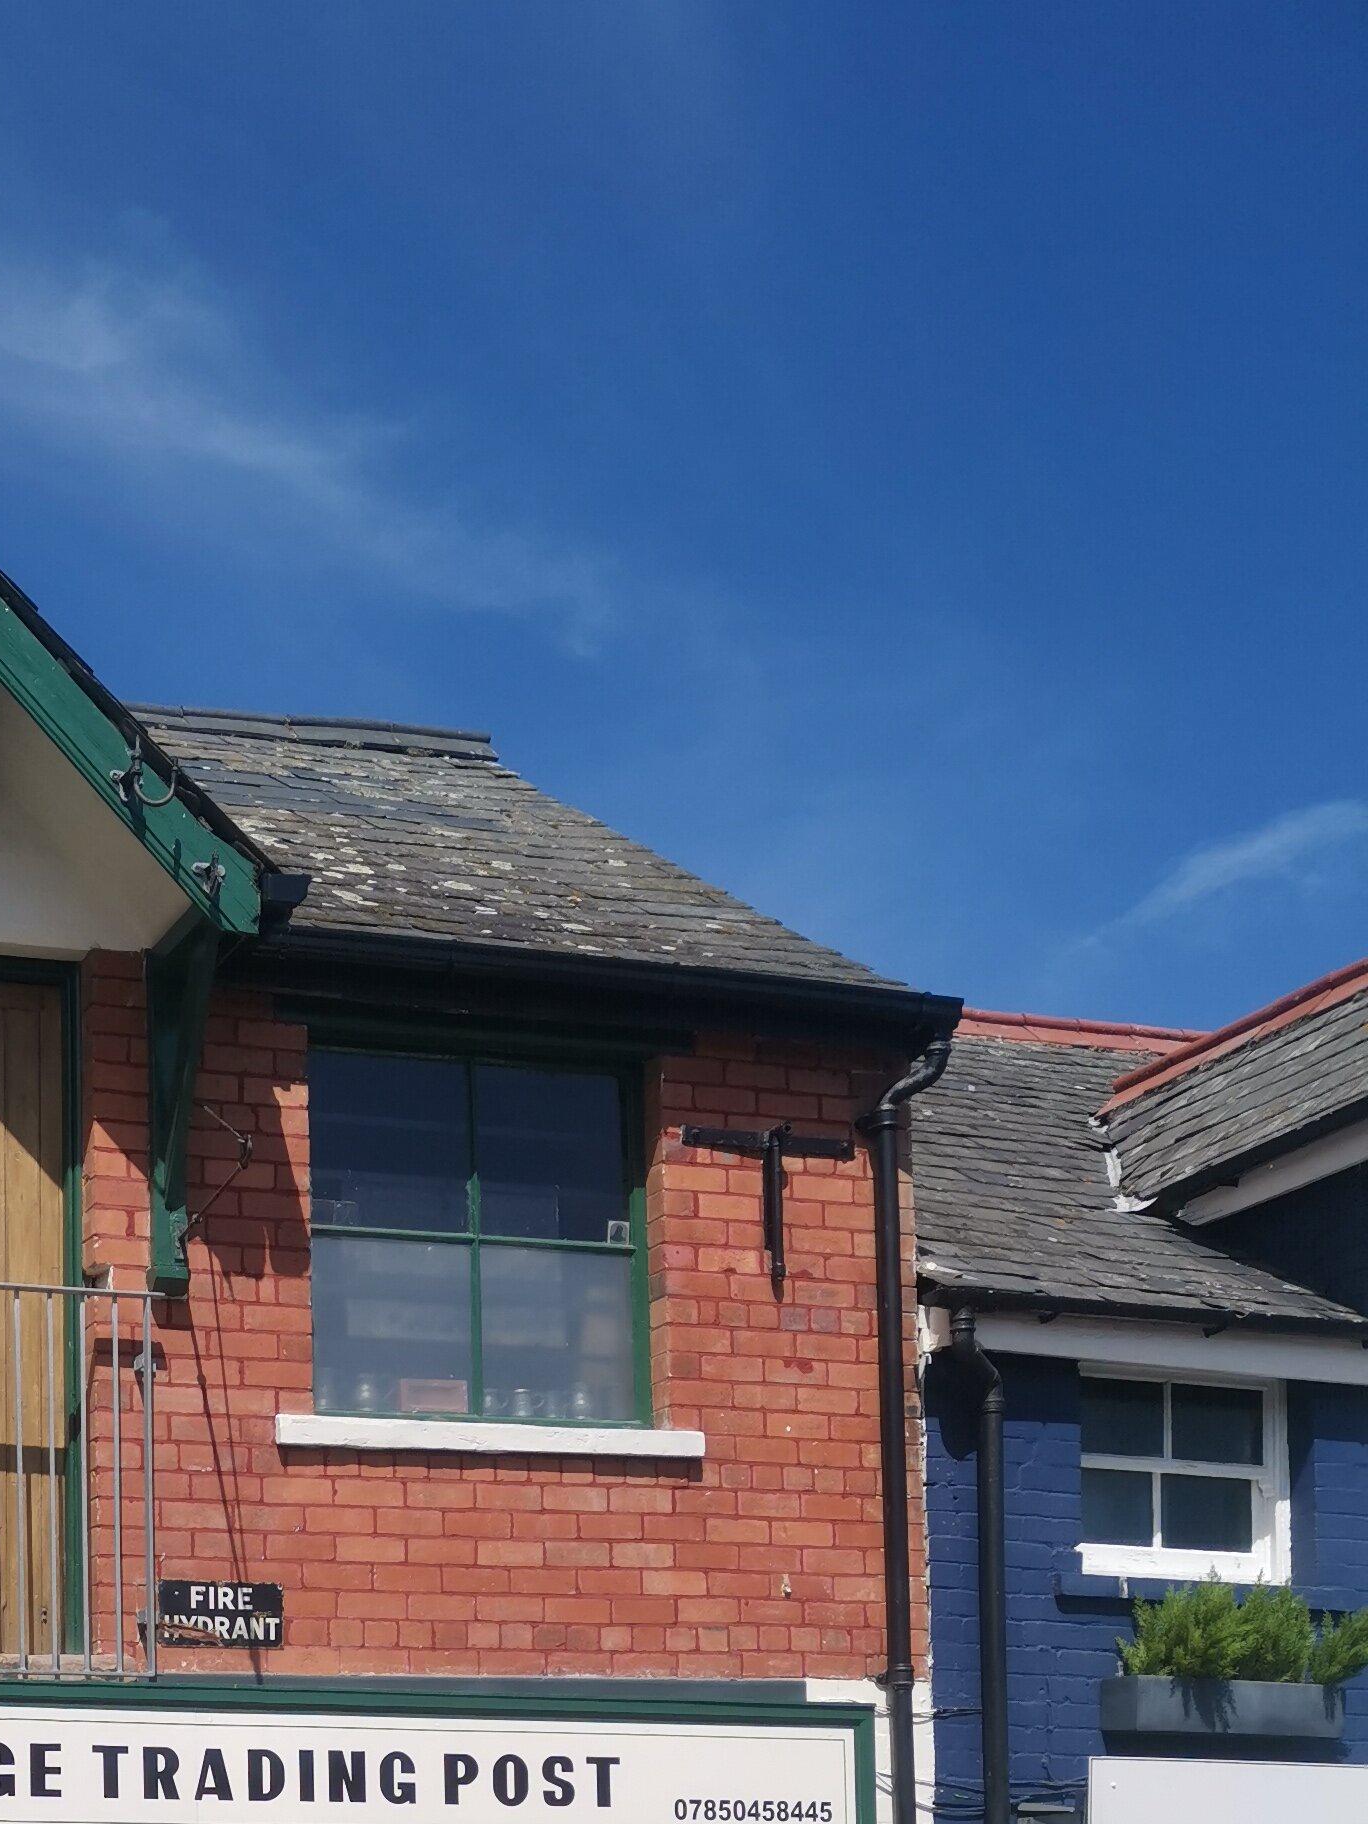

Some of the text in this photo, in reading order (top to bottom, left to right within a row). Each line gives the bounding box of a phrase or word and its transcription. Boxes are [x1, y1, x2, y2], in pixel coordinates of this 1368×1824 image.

[189, 1585, 254, 1610] FIRE
[91, 1744, 417, 1806] TRADING
[443, 1752, 621, 1808] POST
[673, 1798, 833, 1823] 07850458445
